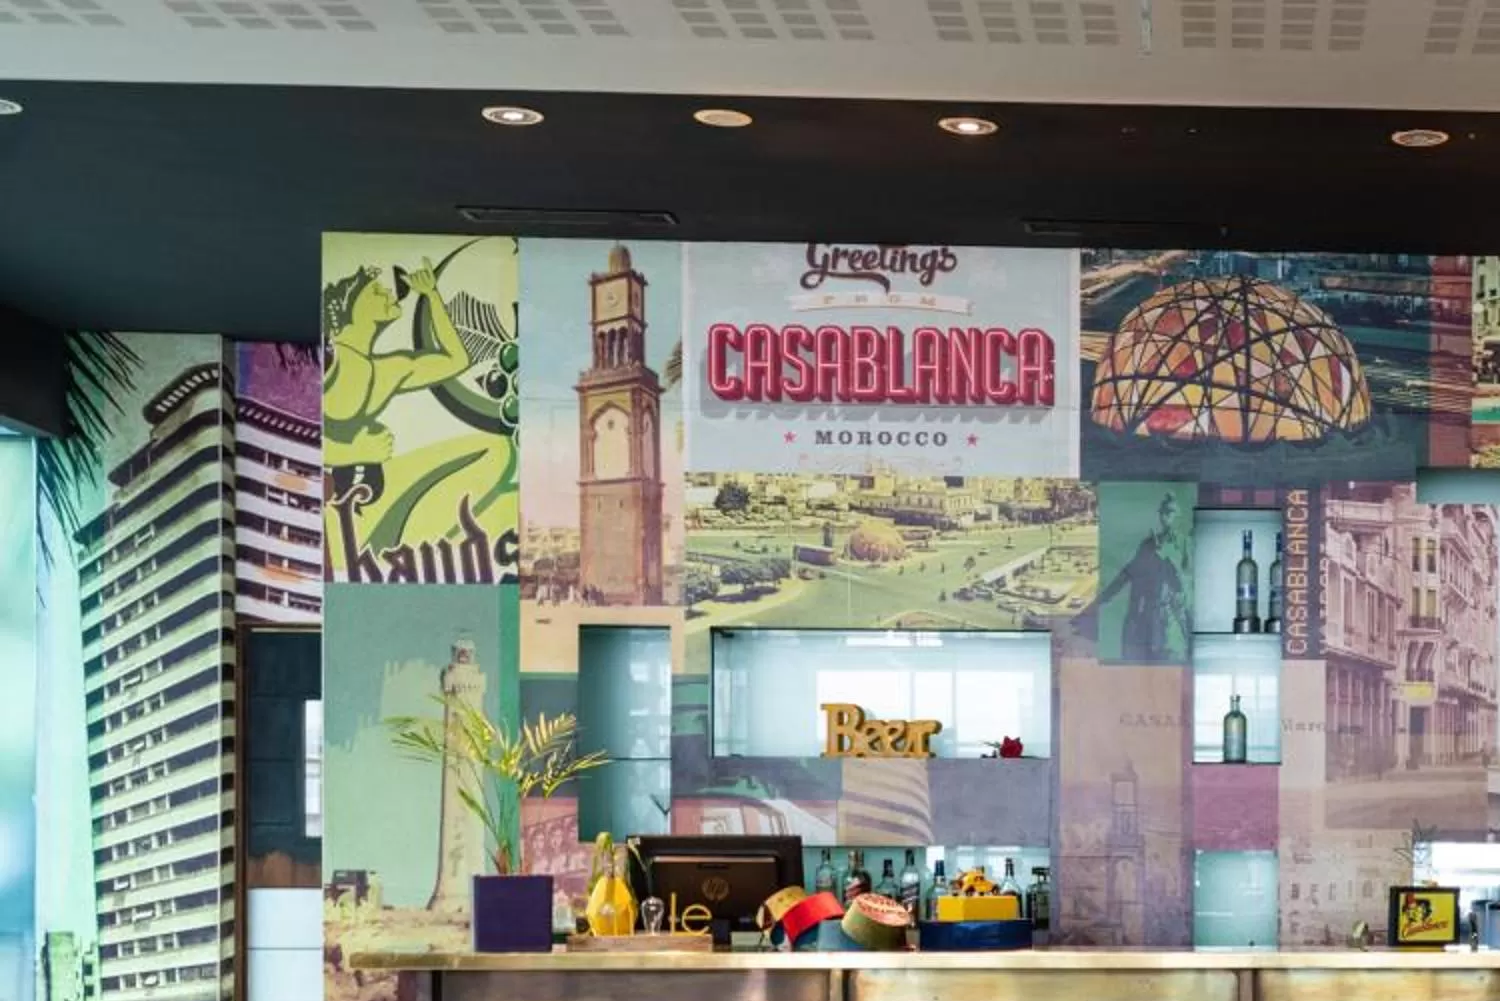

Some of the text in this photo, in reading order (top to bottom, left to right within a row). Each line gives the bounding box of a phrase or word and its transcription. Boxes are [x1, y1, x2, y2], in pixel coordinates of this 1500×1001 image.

[708, 323, 1055, 407] CASABLANCA
[815, 430, 948, 447] MOROCCO
[1287, 489, 1308, 655] CASABLANCA
[820, 703, 943, 758] Beer
